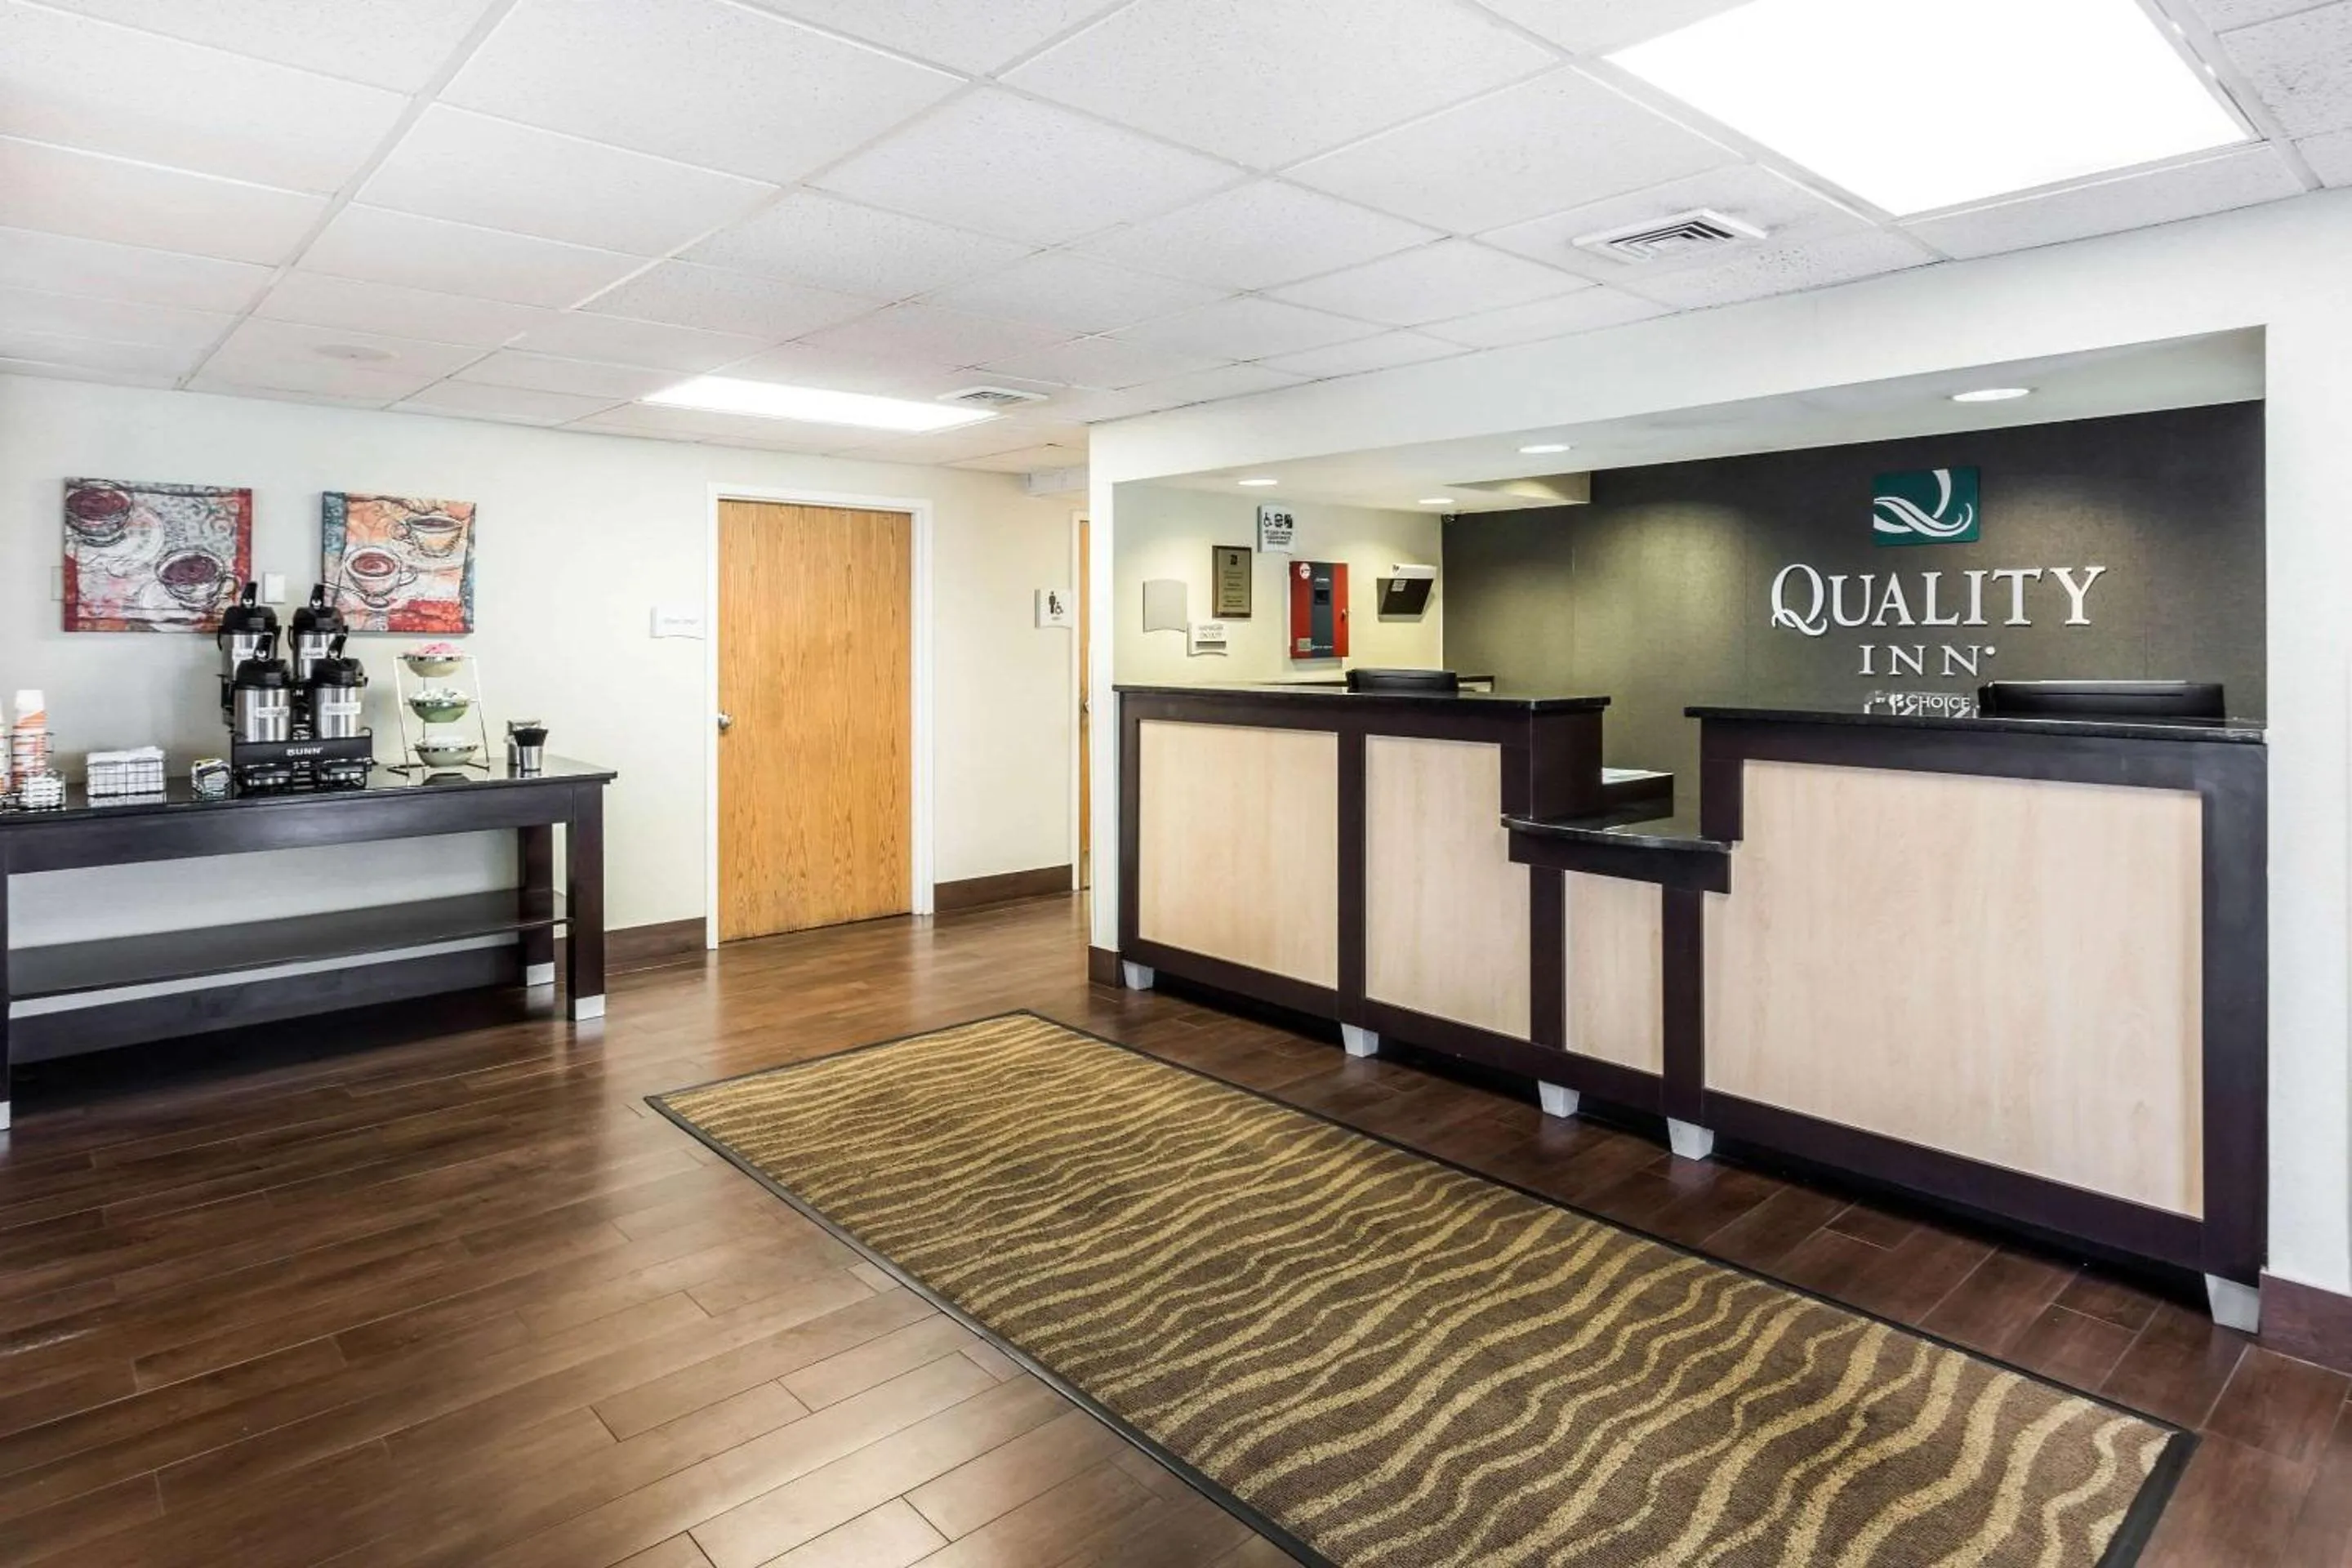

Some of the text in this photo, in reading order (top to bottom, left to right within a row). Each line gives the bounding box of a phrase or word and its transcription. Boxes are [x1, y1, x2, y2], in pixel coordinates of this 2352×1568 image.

[1771, 564, 2108, 636] QUALITY
[1858, 644, 1980, 676] INN
[1906, 694, 1971, 710] CHOICE
[286, 747, 321, 756] BUNN
